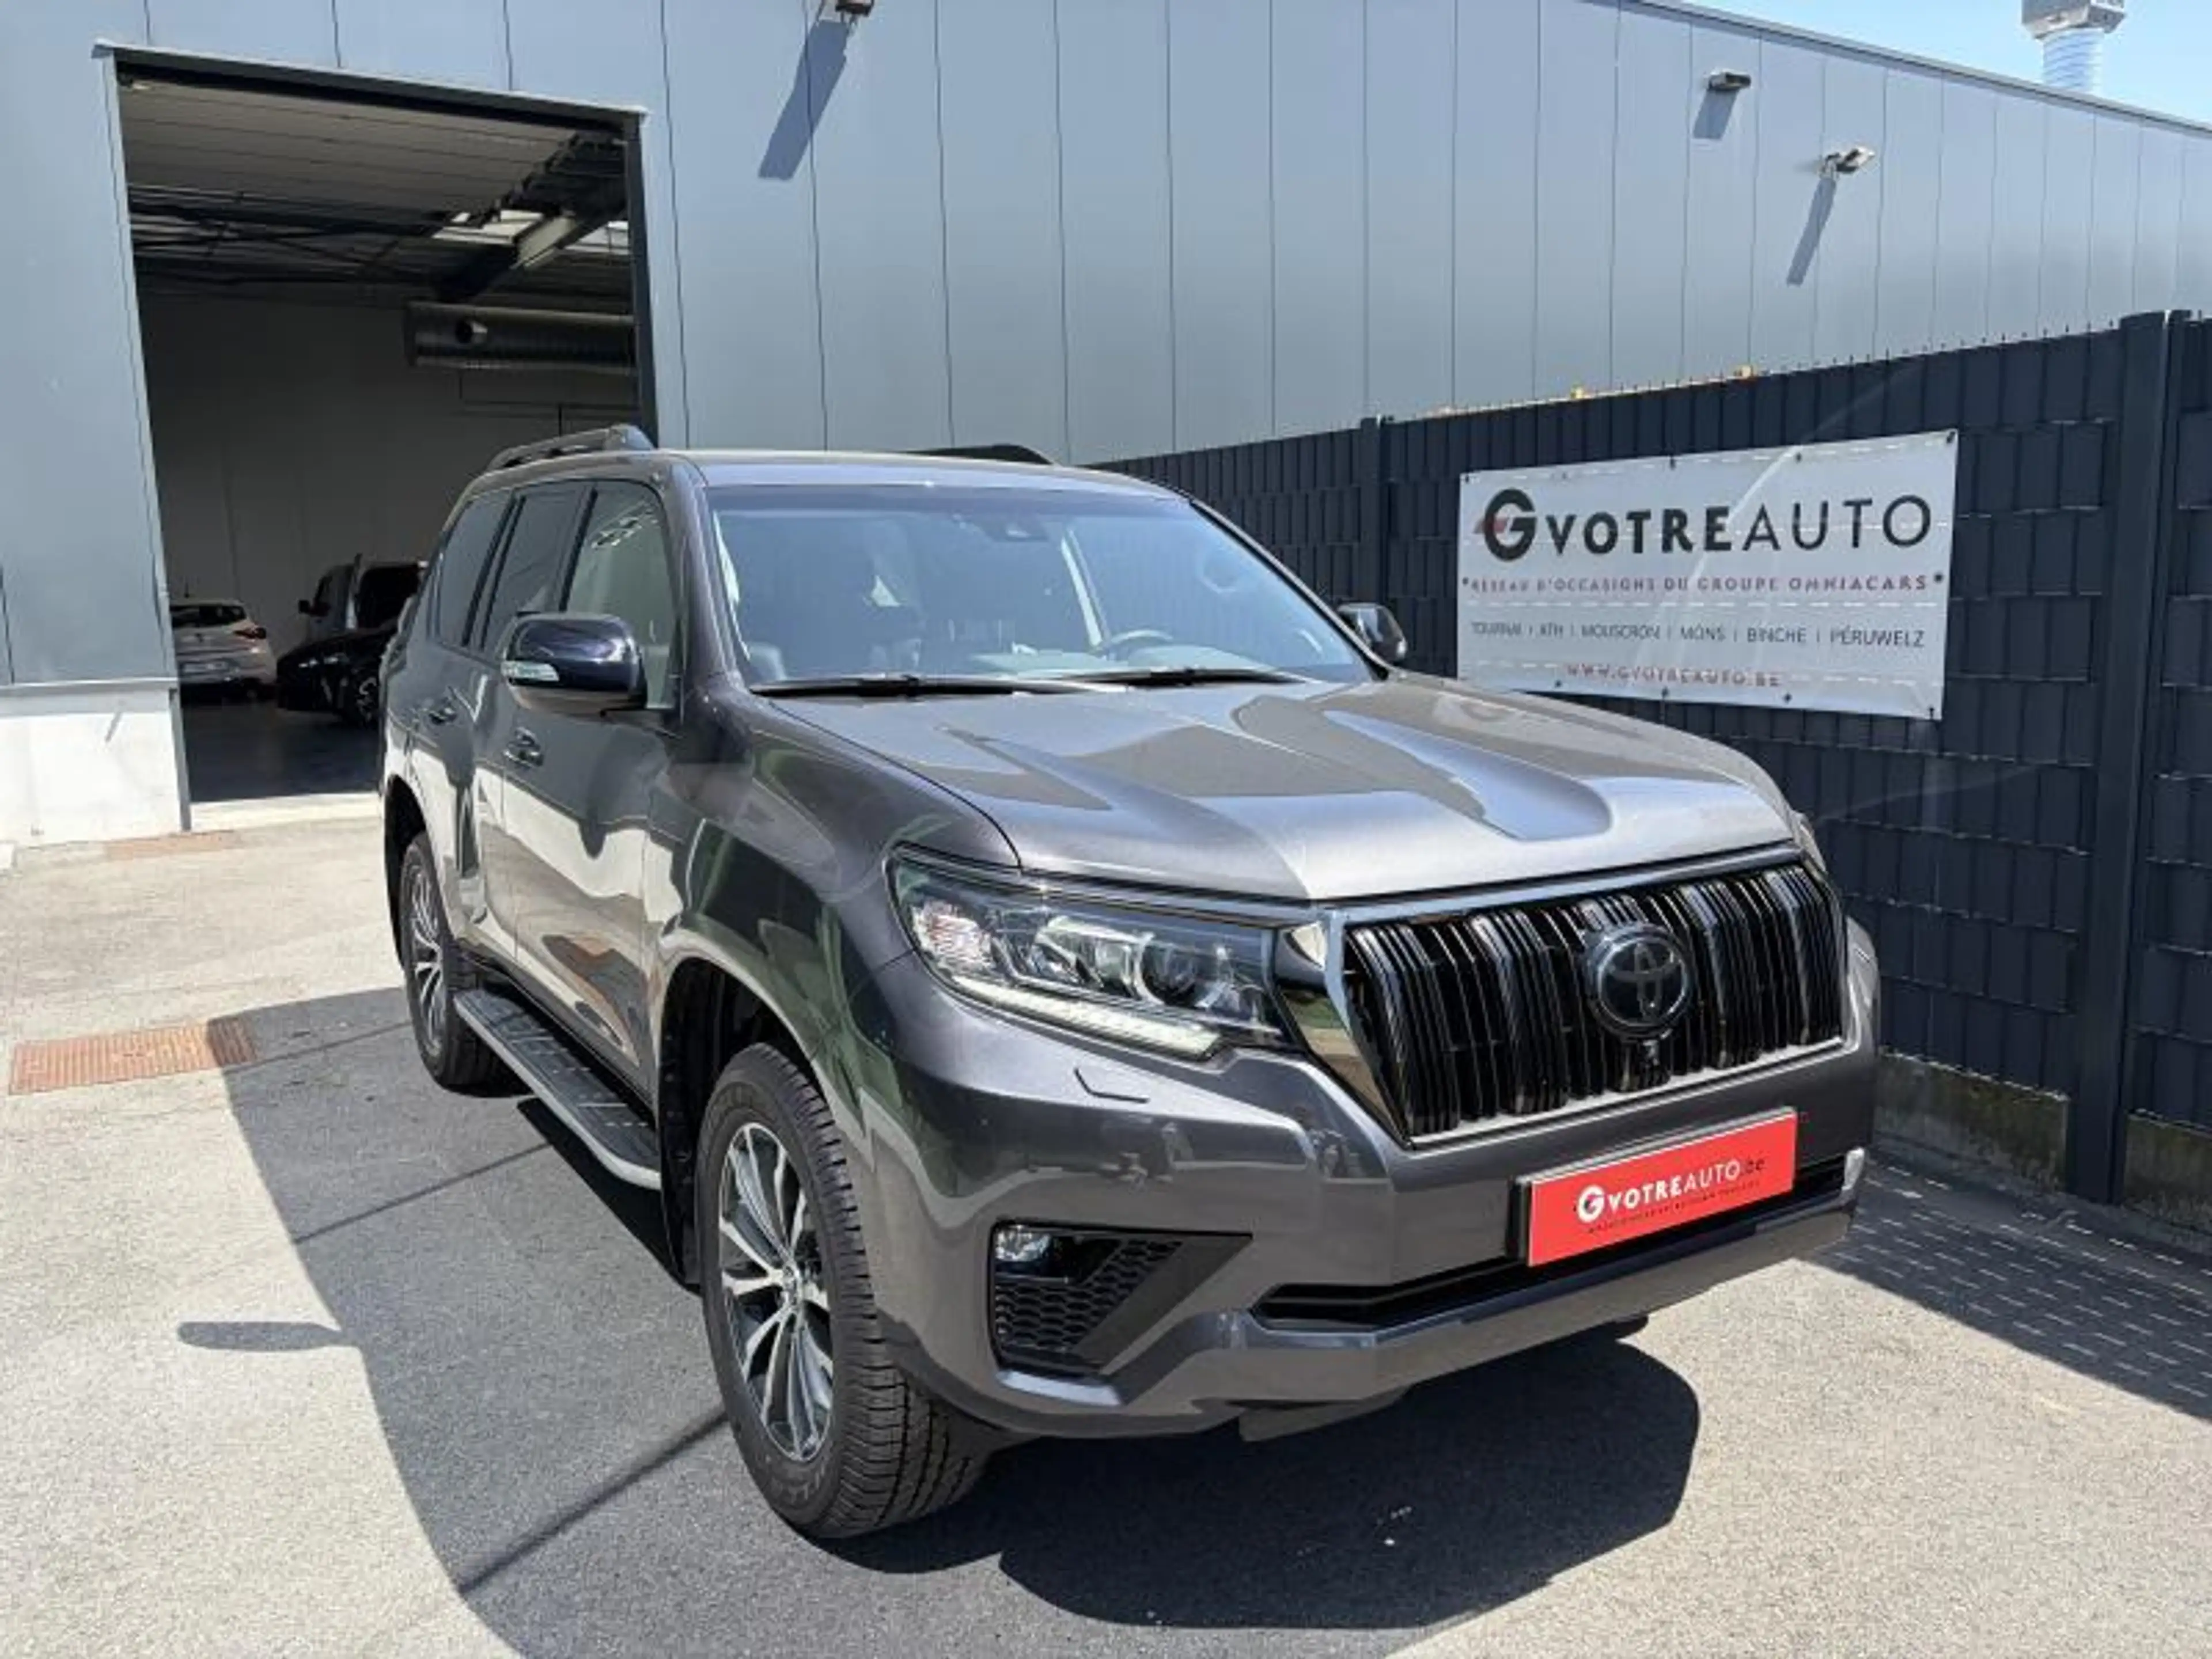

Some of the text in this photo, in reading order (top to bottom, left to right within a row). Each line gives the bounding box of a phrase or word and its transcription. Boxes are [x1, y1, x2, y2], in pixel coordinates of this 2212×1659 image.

[1664, 578, 1689, 592] DU
[1697, 576, 1779, 592] GROUPE
[1789, 574, 1927, 592] OMNIACARS
[1540, 622, 1563, 637] ATH
[1581, 623, 1661, 639] MOUSCRON
[1680, 624, 1726, 642] MONS
[1747, 627, 1807, 643] BINCHE
[1830, 625, 1925, 647] PÉRUWELZ
